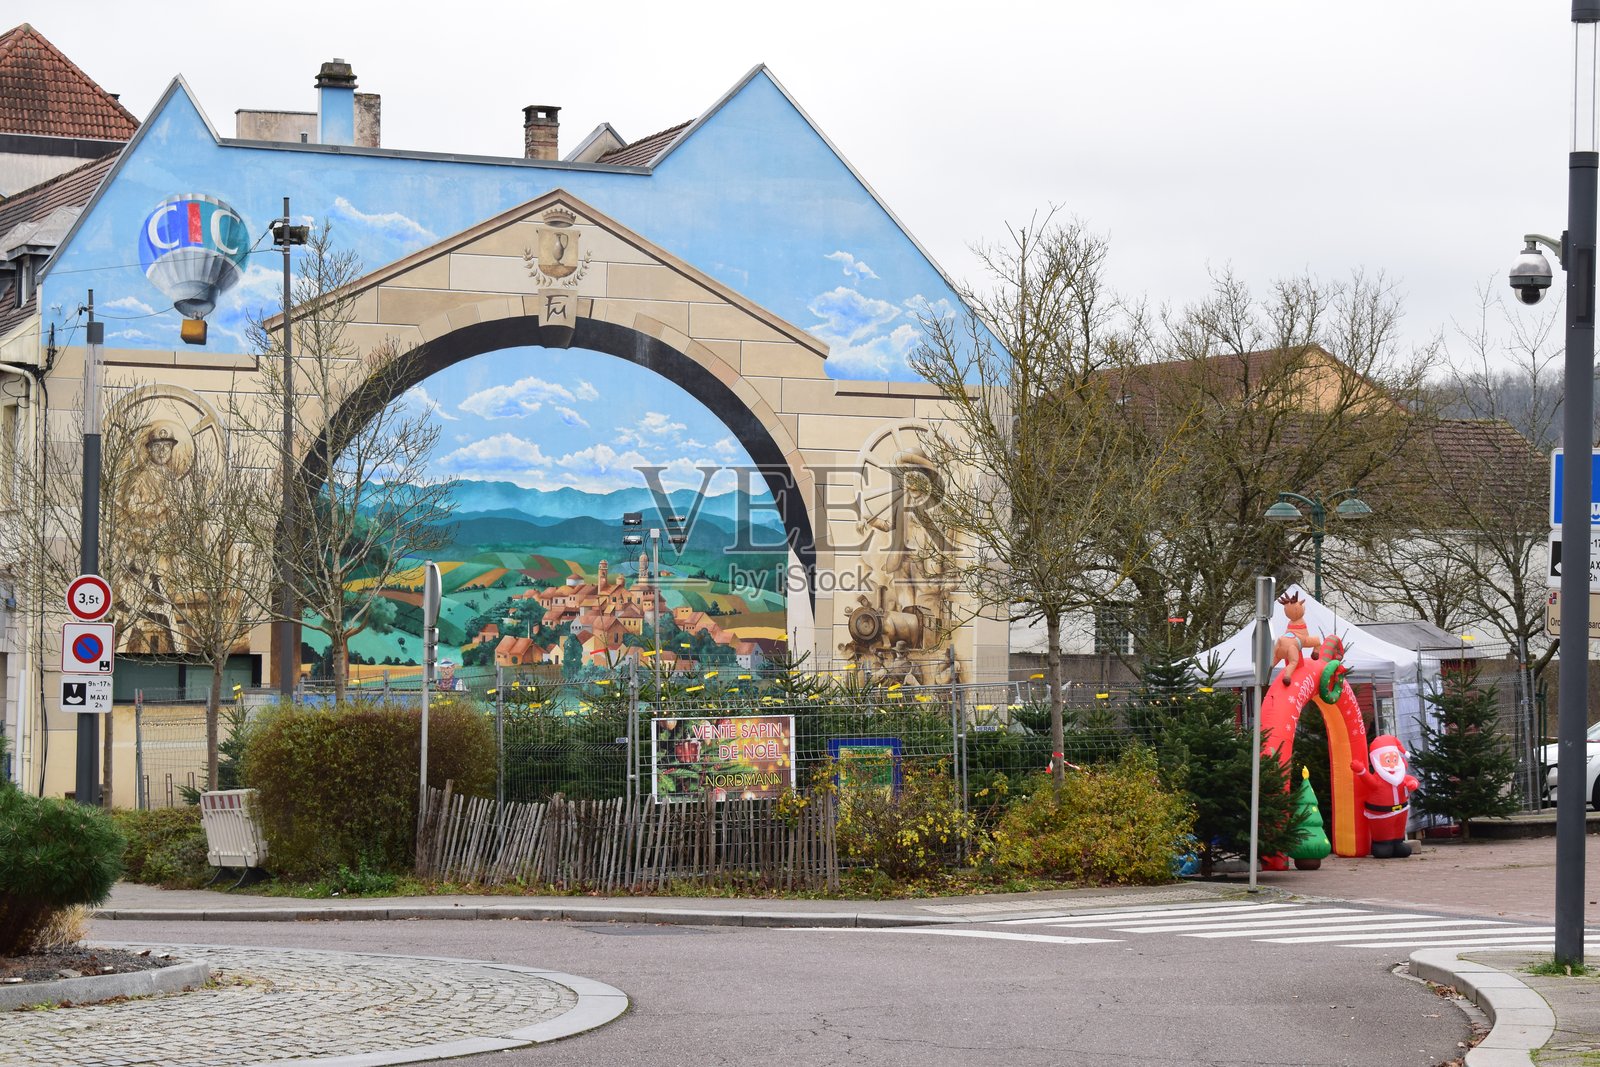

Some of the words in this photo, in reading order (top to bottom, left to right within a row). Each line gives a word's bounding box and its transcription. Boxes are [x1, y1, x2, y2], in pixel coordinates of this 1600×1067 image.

[148, 205, 240, 254] CIC
[1590, 560, 1600, 570] AX
[78, 593, 99, 605] 3,5t
[692, 724, 736, 740] VENTE
[741, 723, 783, 739] SAPIN
[719, 744, 738, 760] DE
[743, 741, 783, 760] NOËL
[705, 773, 783, 787] NORDMANN
